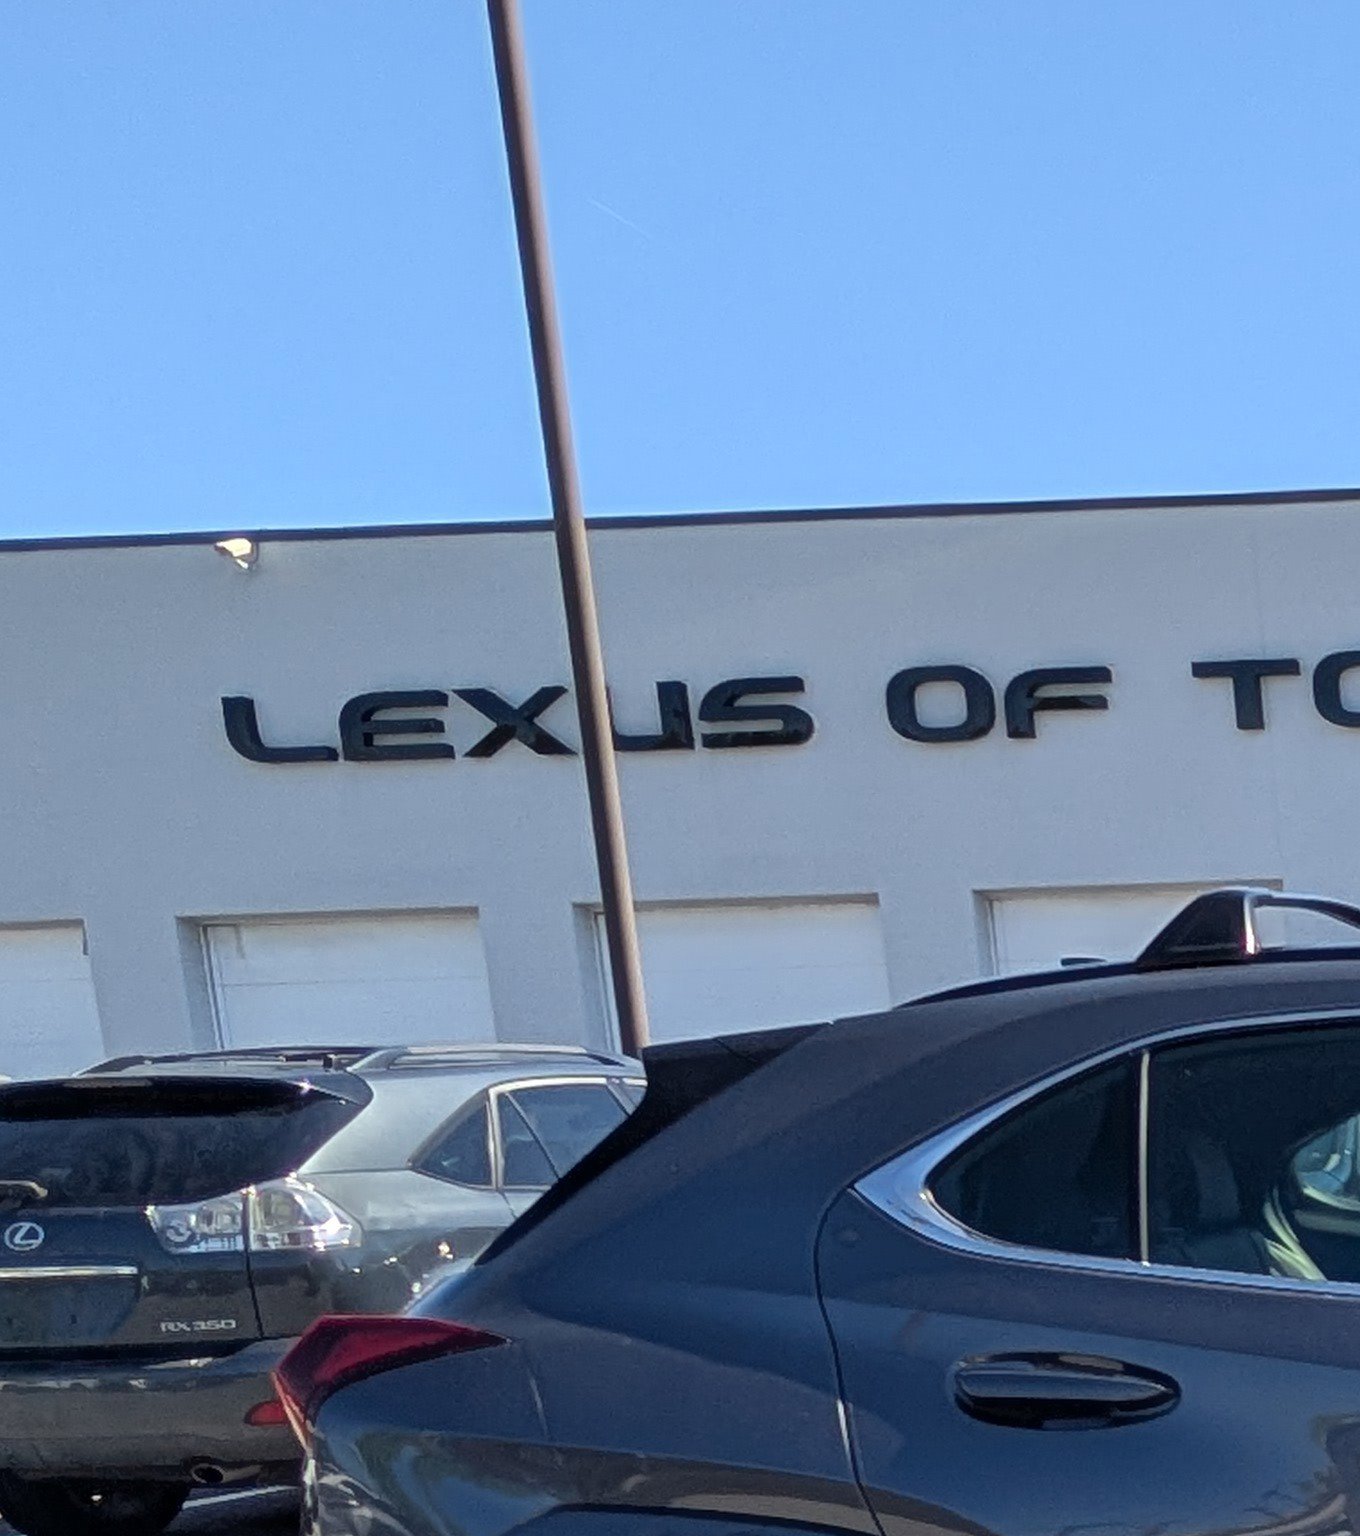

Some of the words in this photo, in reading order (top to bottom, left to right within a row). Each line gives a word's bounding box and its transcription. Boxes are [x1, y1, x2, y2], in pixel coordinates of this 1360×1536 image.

[220, 675, 817, 763] LEXUS
[884, 664, 1113, 743] OF
[160, 1321, 191, 1332] RX
[192, 1319, 237, 1331] 350
